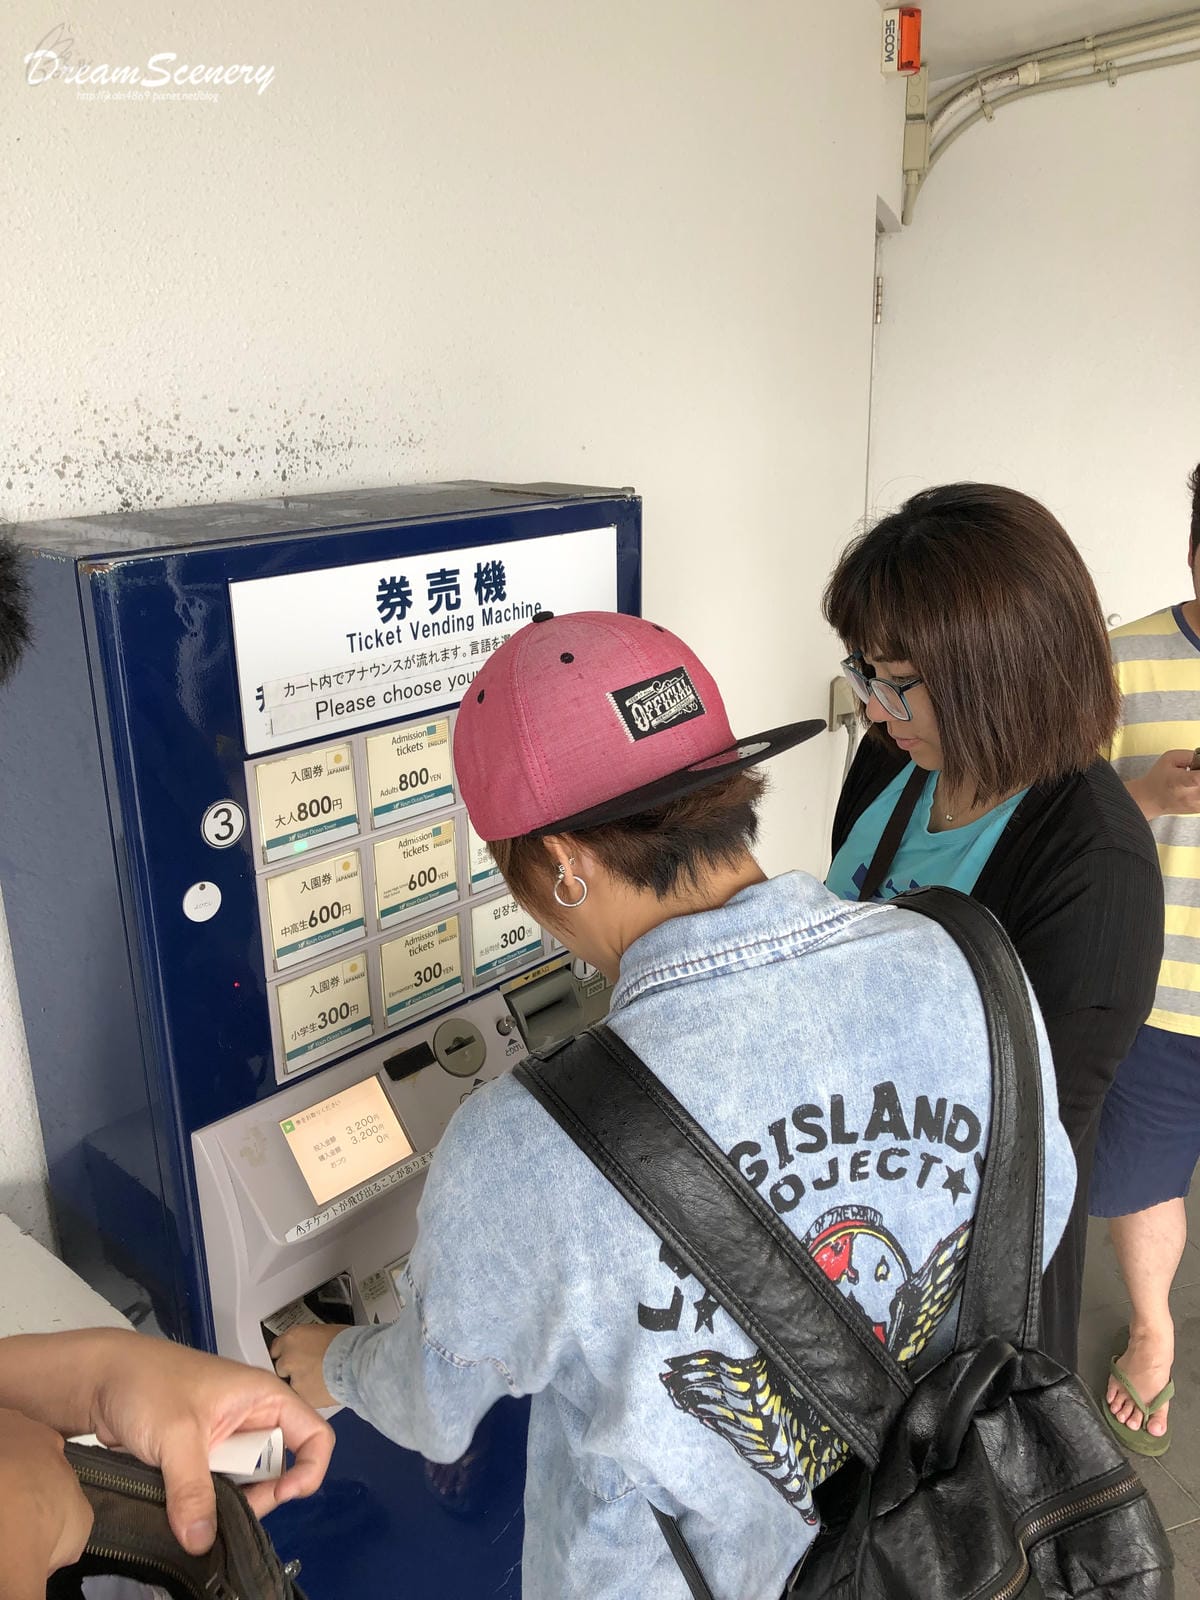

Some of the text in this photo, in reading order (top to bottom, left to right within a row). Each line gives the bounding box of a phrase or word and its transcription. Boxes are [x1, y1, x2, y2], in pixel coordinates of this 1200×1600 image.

[884, 19, 896, 63] SECOM
[376, 561, 508, 624] 券売機
[346, 600, 542, 653] Ticket Vending Machine
[316, 670, 479, 721] Please choose you
[631, 678, 692, 732] OFFICIAL
[392, 730, 427, 745] Admission
[396, 742, 424, 757] tickets
[291, 765, 323, 784] 入園券
[327, 765, 350, 776] JAPANESE
[380, 767, 442, 797] Adults 800 YEN
[213, 807, 234, 841] 3
[398, 832, 433, 849] Admission
[402, 843, 430, 859] tickets
[300, 872, 333, 894] 入園券
[407, 866, 449, 892] 600 YEN
[404, 928, 438, 948] Admission
[408, 940, 435, 957] tickets
[413, 962, 443, 987] 300
[442, 965, 454, 975] YEN
[309, 976, 341, 997] 入園券
